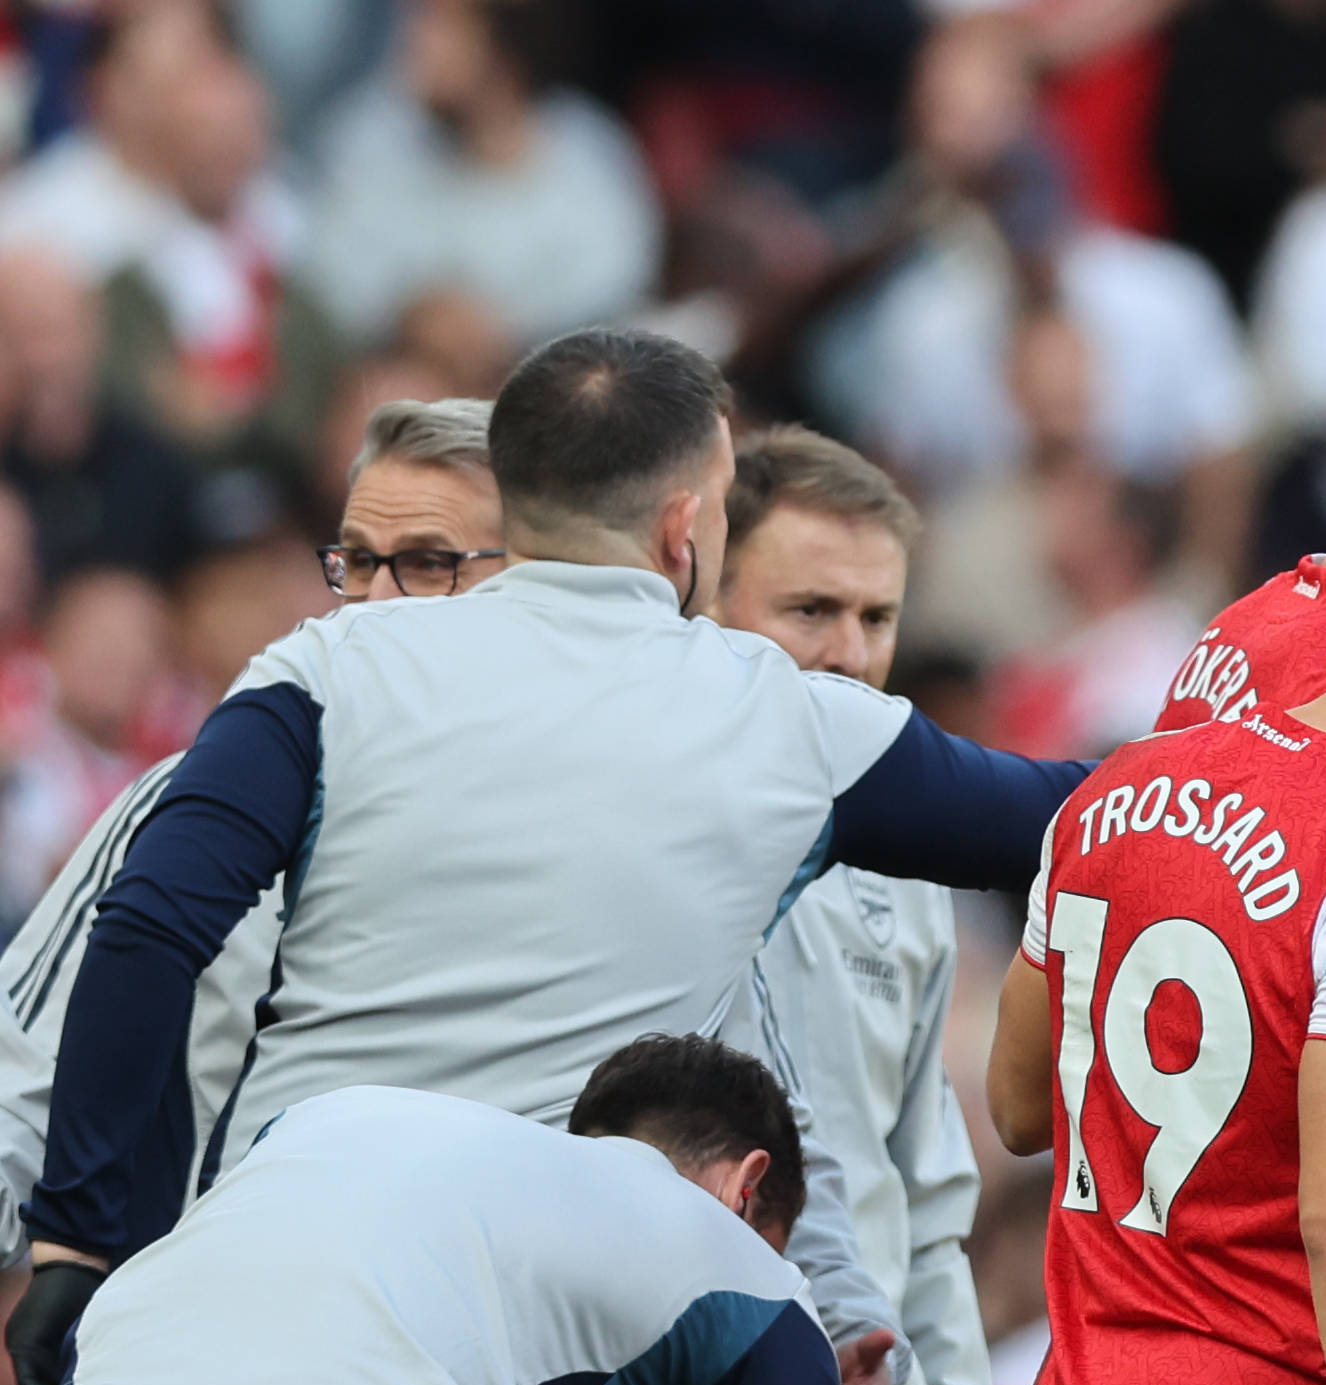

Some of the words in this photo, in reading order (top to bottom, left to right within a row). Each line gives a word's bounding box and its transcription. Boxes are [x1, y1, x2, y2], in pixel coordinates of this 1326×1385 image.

[1241, 713, 1313, 752] Arsenal
[1079, 775, 1302, 922] TROSSARD
[1049, 889, 1254, 1238] 19
